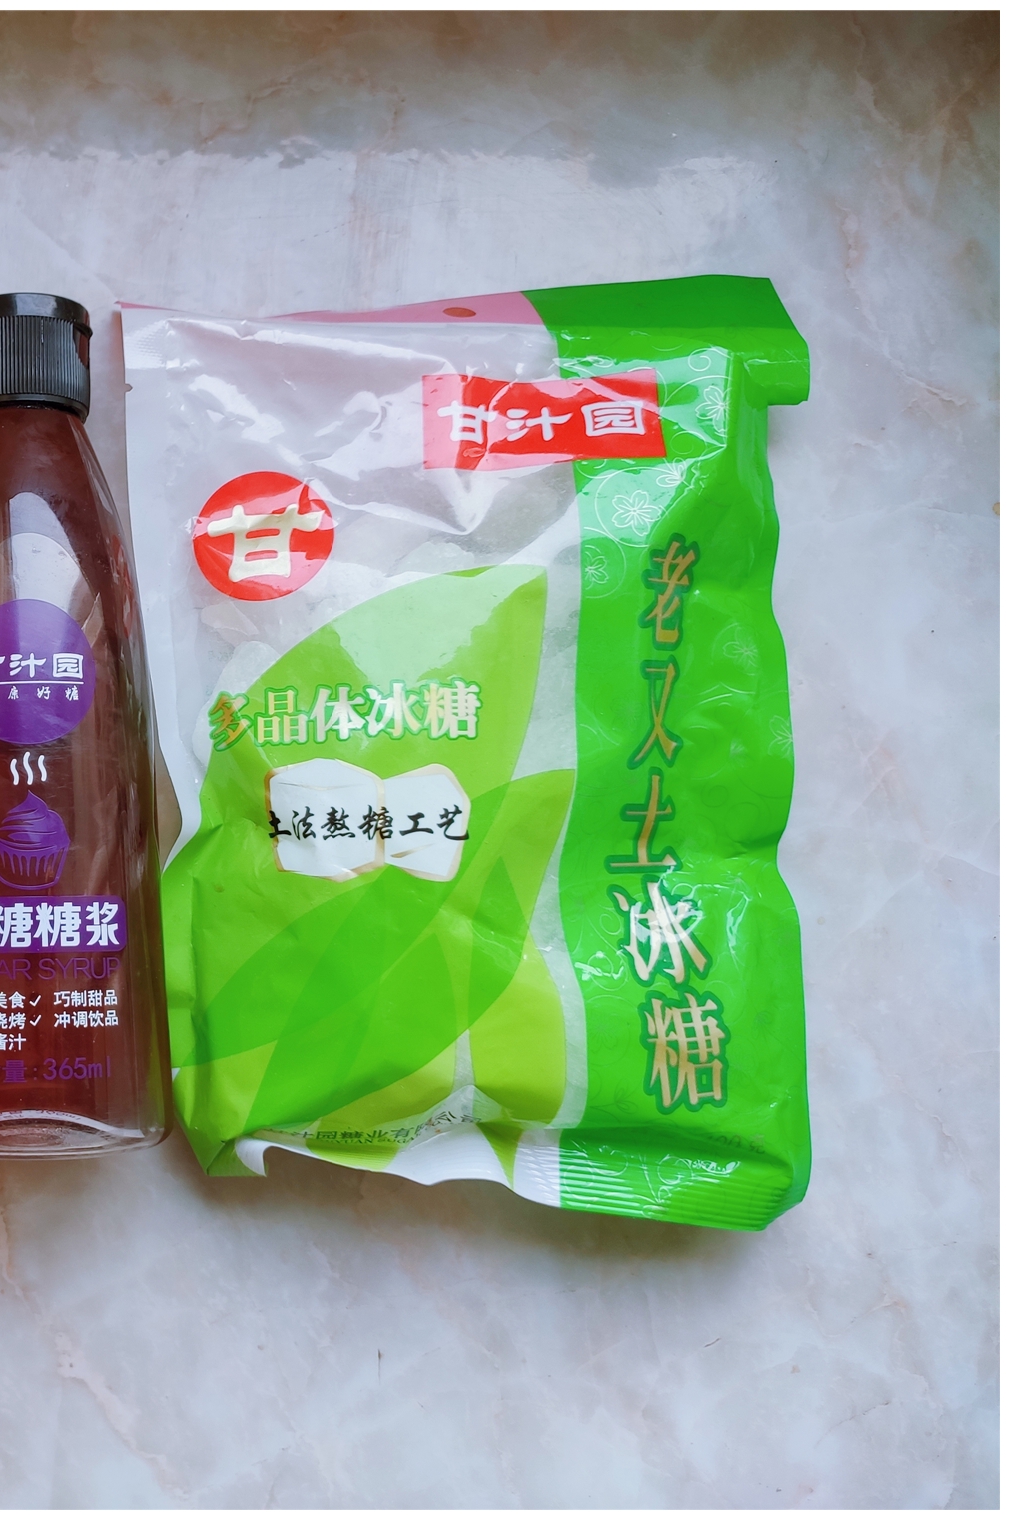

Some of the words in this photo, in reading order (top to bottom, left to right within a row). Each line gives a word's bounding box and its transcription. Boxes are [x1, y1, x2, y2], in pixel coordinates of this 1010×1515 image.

[437, 400, 646, 444] 甘汁园
[207, 504, 326, 583] 甘
[210, 680, 481, 750] 多晶体冰糖
[268, 804, 470, 841] 土法熬糖工艺
[609, 540, 727, 1108] 老又土冰糖
[38, 957, 120, 980] SYRUP
[53, 989, 118, 1007] 巧制甜品
[54, 1010, 119, 1028] 冲调饮品
